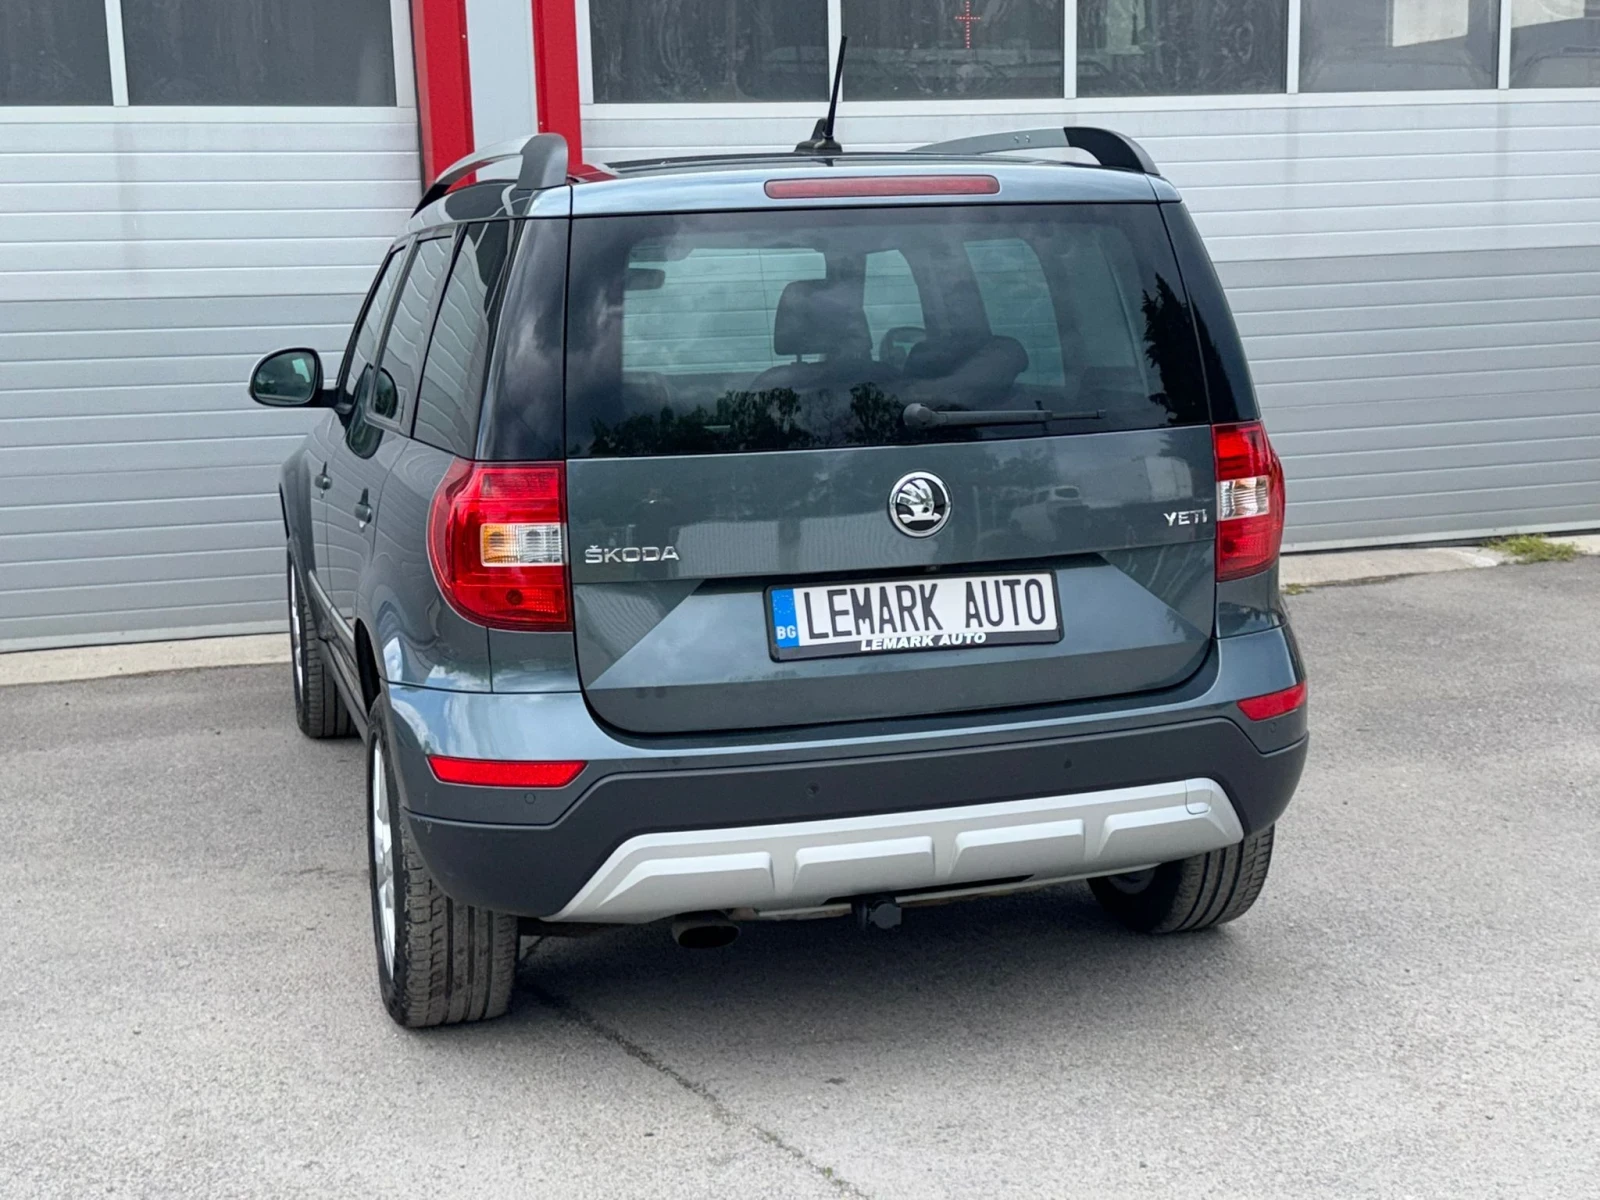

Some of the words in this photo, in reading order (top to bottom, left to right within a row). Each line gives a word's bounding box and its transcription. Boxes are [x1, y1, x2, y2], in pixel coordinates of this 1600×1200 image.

[1163, 508, 1208, 526] YETI
[584, 545, 680, 564] ŠKODA
[803, 583, 943, 640] LEMARK
[965, 578, 1046, 629] AUTO
[776, 625, 797, 640] BG
[860, 634, 935, 652] LEMARK
[938, 632, 987, 646] AUTO
